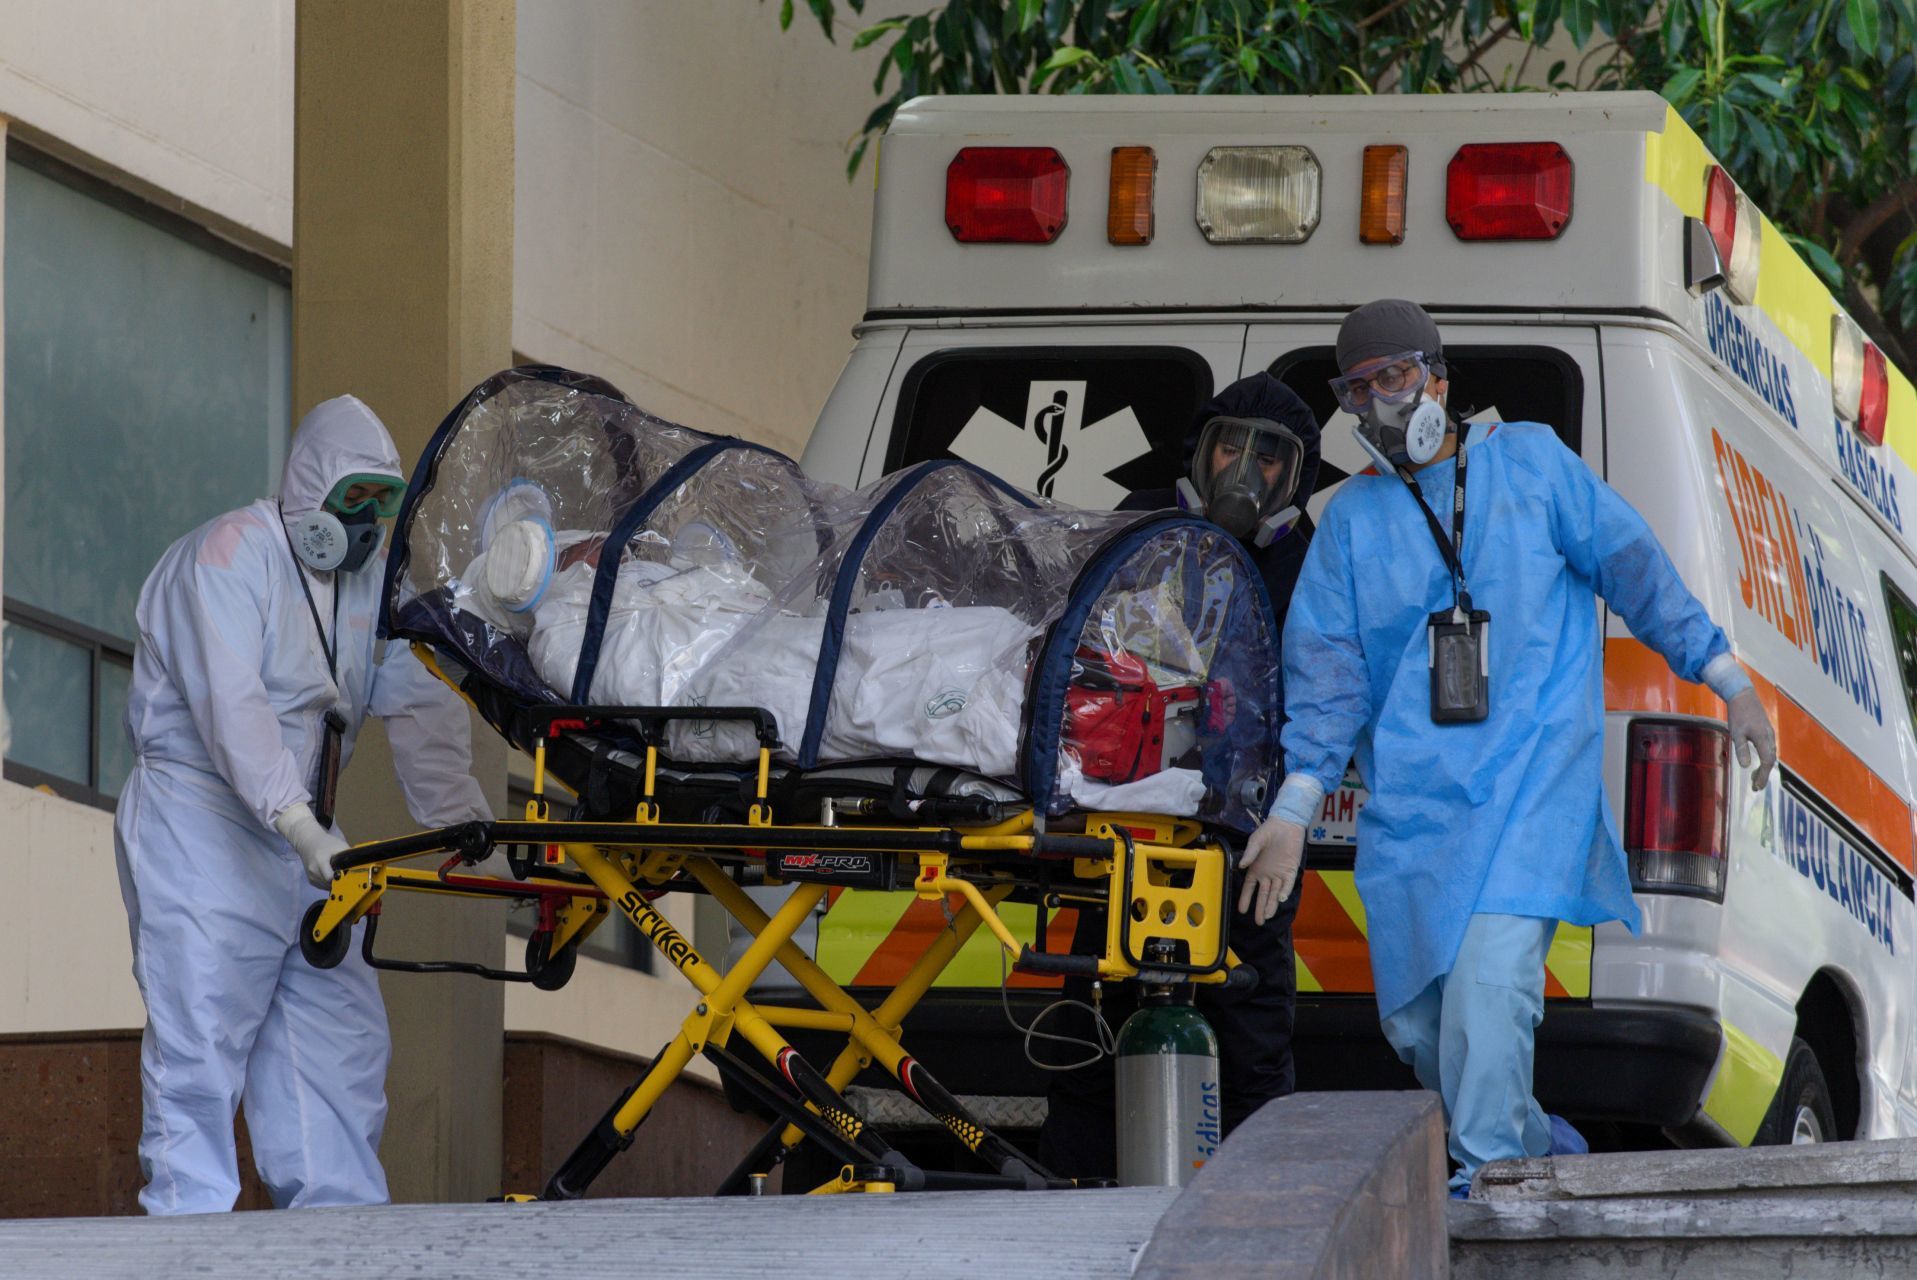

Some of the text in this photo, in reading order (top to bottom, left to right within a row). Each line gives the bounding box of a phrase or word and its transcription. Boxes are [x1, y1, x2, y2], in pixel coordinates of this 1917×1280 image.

[1704, 288, 1798, 430] URGENCIAS
[783, 854, 867, 869] MX-PRO
[1761, 781, 1894, 957] AMBULANCIA
[618, 891, 700, 969] stryker
[1194, 1081, 1220, 1168] édicas
